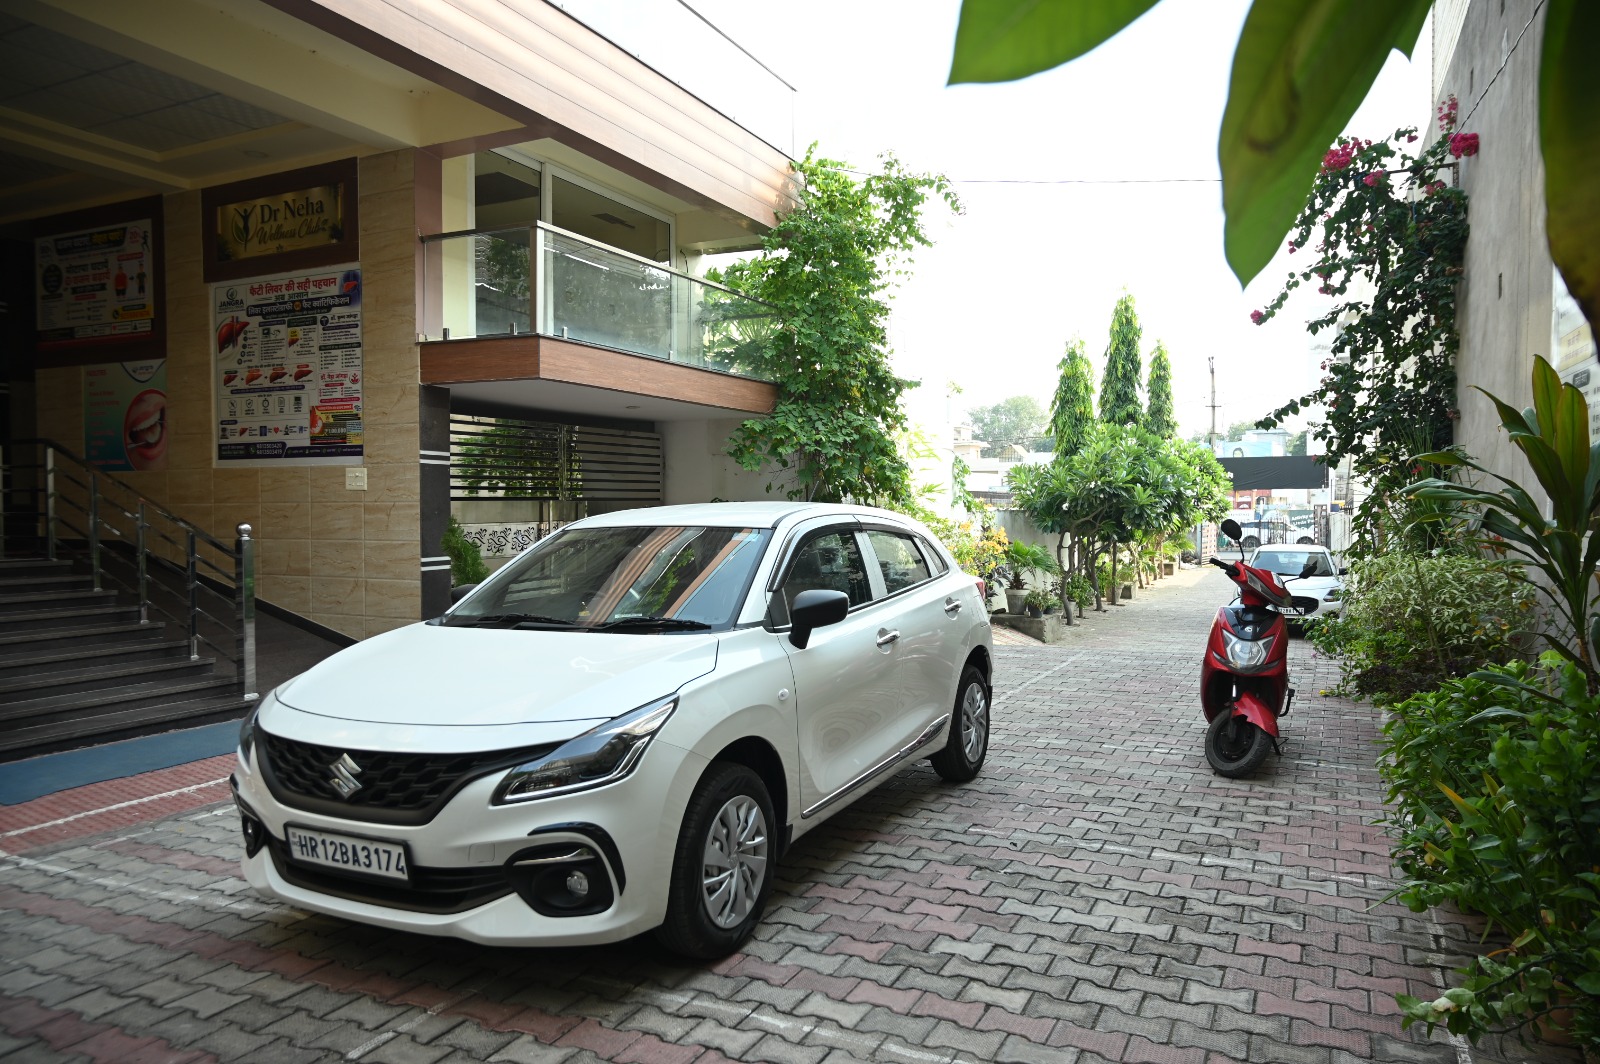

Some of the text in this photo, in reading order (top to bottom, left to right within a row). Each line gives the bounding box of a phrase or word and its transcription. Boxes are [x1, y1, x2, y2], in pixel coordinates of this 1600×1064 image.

[259, 196, 324, 224] Dr Neha
[256, 216, 321, 245] Wellness Club
[265, 282, 283, 295] लिवर
[285, 280, 295, 292] की
[296, 278, 310, 291] सही
[312, 277, 337, 289] पहचान
[218, 298, 244, 308] JANGRA
[274, 291, 309, 302] अब आसान
[248, 307, 262, 316] लिवर
[298, 834, 406, 875] HR12BA3174
